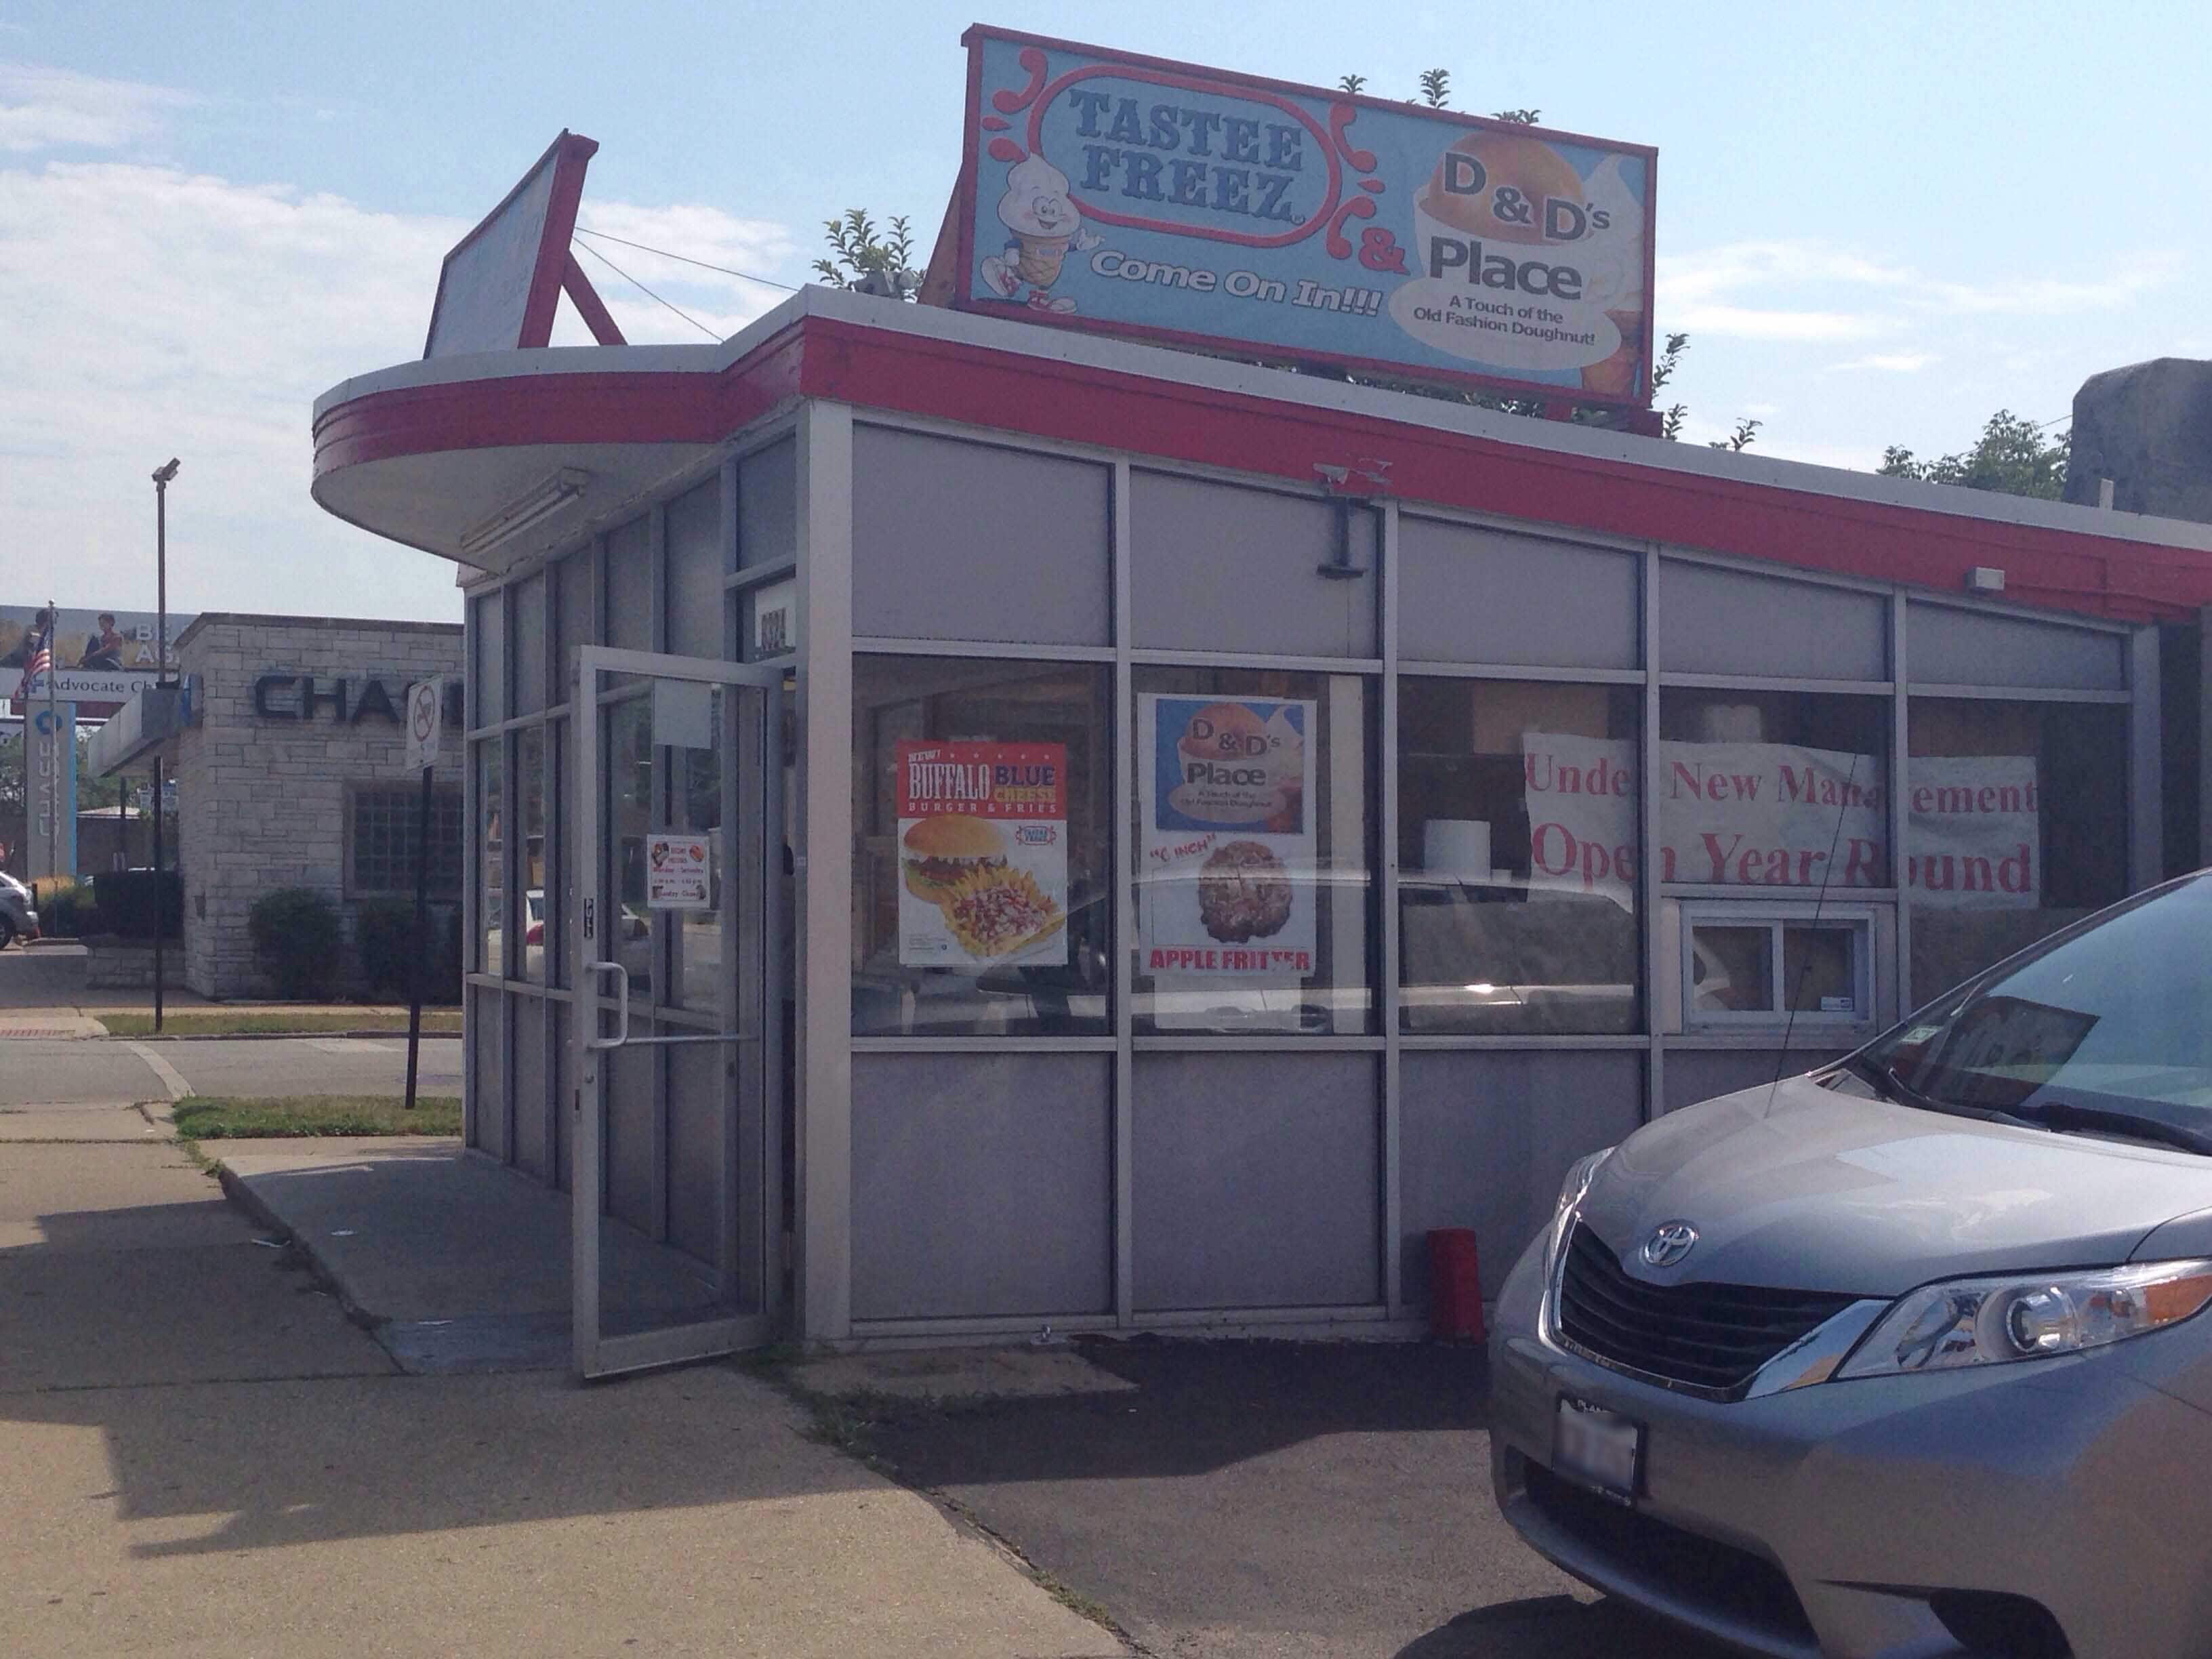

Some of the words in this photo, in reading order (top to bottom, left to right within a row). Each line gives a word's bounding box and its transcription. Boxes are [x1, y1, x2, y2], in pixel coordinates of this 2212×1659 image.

[1069, 89, 1302, 171] TASTEE
[1080, 145, 1293, 224] FREEZ
[1445, 152, 1486, 194] D
[1492, 187, 1533, 224] &
[1544, 198, 1610, 241] D's
[1358, 228, 1410, 275] &
[1430, 236, 1580, 300] Place
[1090, 250, 1216, 292] Come
[1224, 271, 1286, 302] On
[1292, 279, 1382, 316] In!!!
[1414, 307, 1441, 322] Old
[1446, 312, 1507, 332] Fashion
[1512, 322, 1595, 346] Doughnut!
[1450, 295, 1461, 308] A
[1465, 297, 1513, 316] Touch
[1518, 306, 1533, 319] of
[1536, 309, 1563, 324] the
[49, 678, 125, 693] Advocate
[1193, 719, 1214, 739] D
[1219, 733, 1236, 750] &
[909, 763, 990, 801] BUFFALO
[996, 765, 1055, 786] BLUE
[1187, 762, 1266, 785] Place
[1526, 753, 1630, 798] Unde
[1670, 761, 1762, 801] New
[1778, 764, 2038, 814] Manaement
[909, 802, 977, 813] BURGER
[1006, 803, 1056, 813] FRIES
[1700, 833, 1827, 887] Year
[1845, 838, 2032, 894] Rund
[1149, 948, 1216, 970] APPLE
